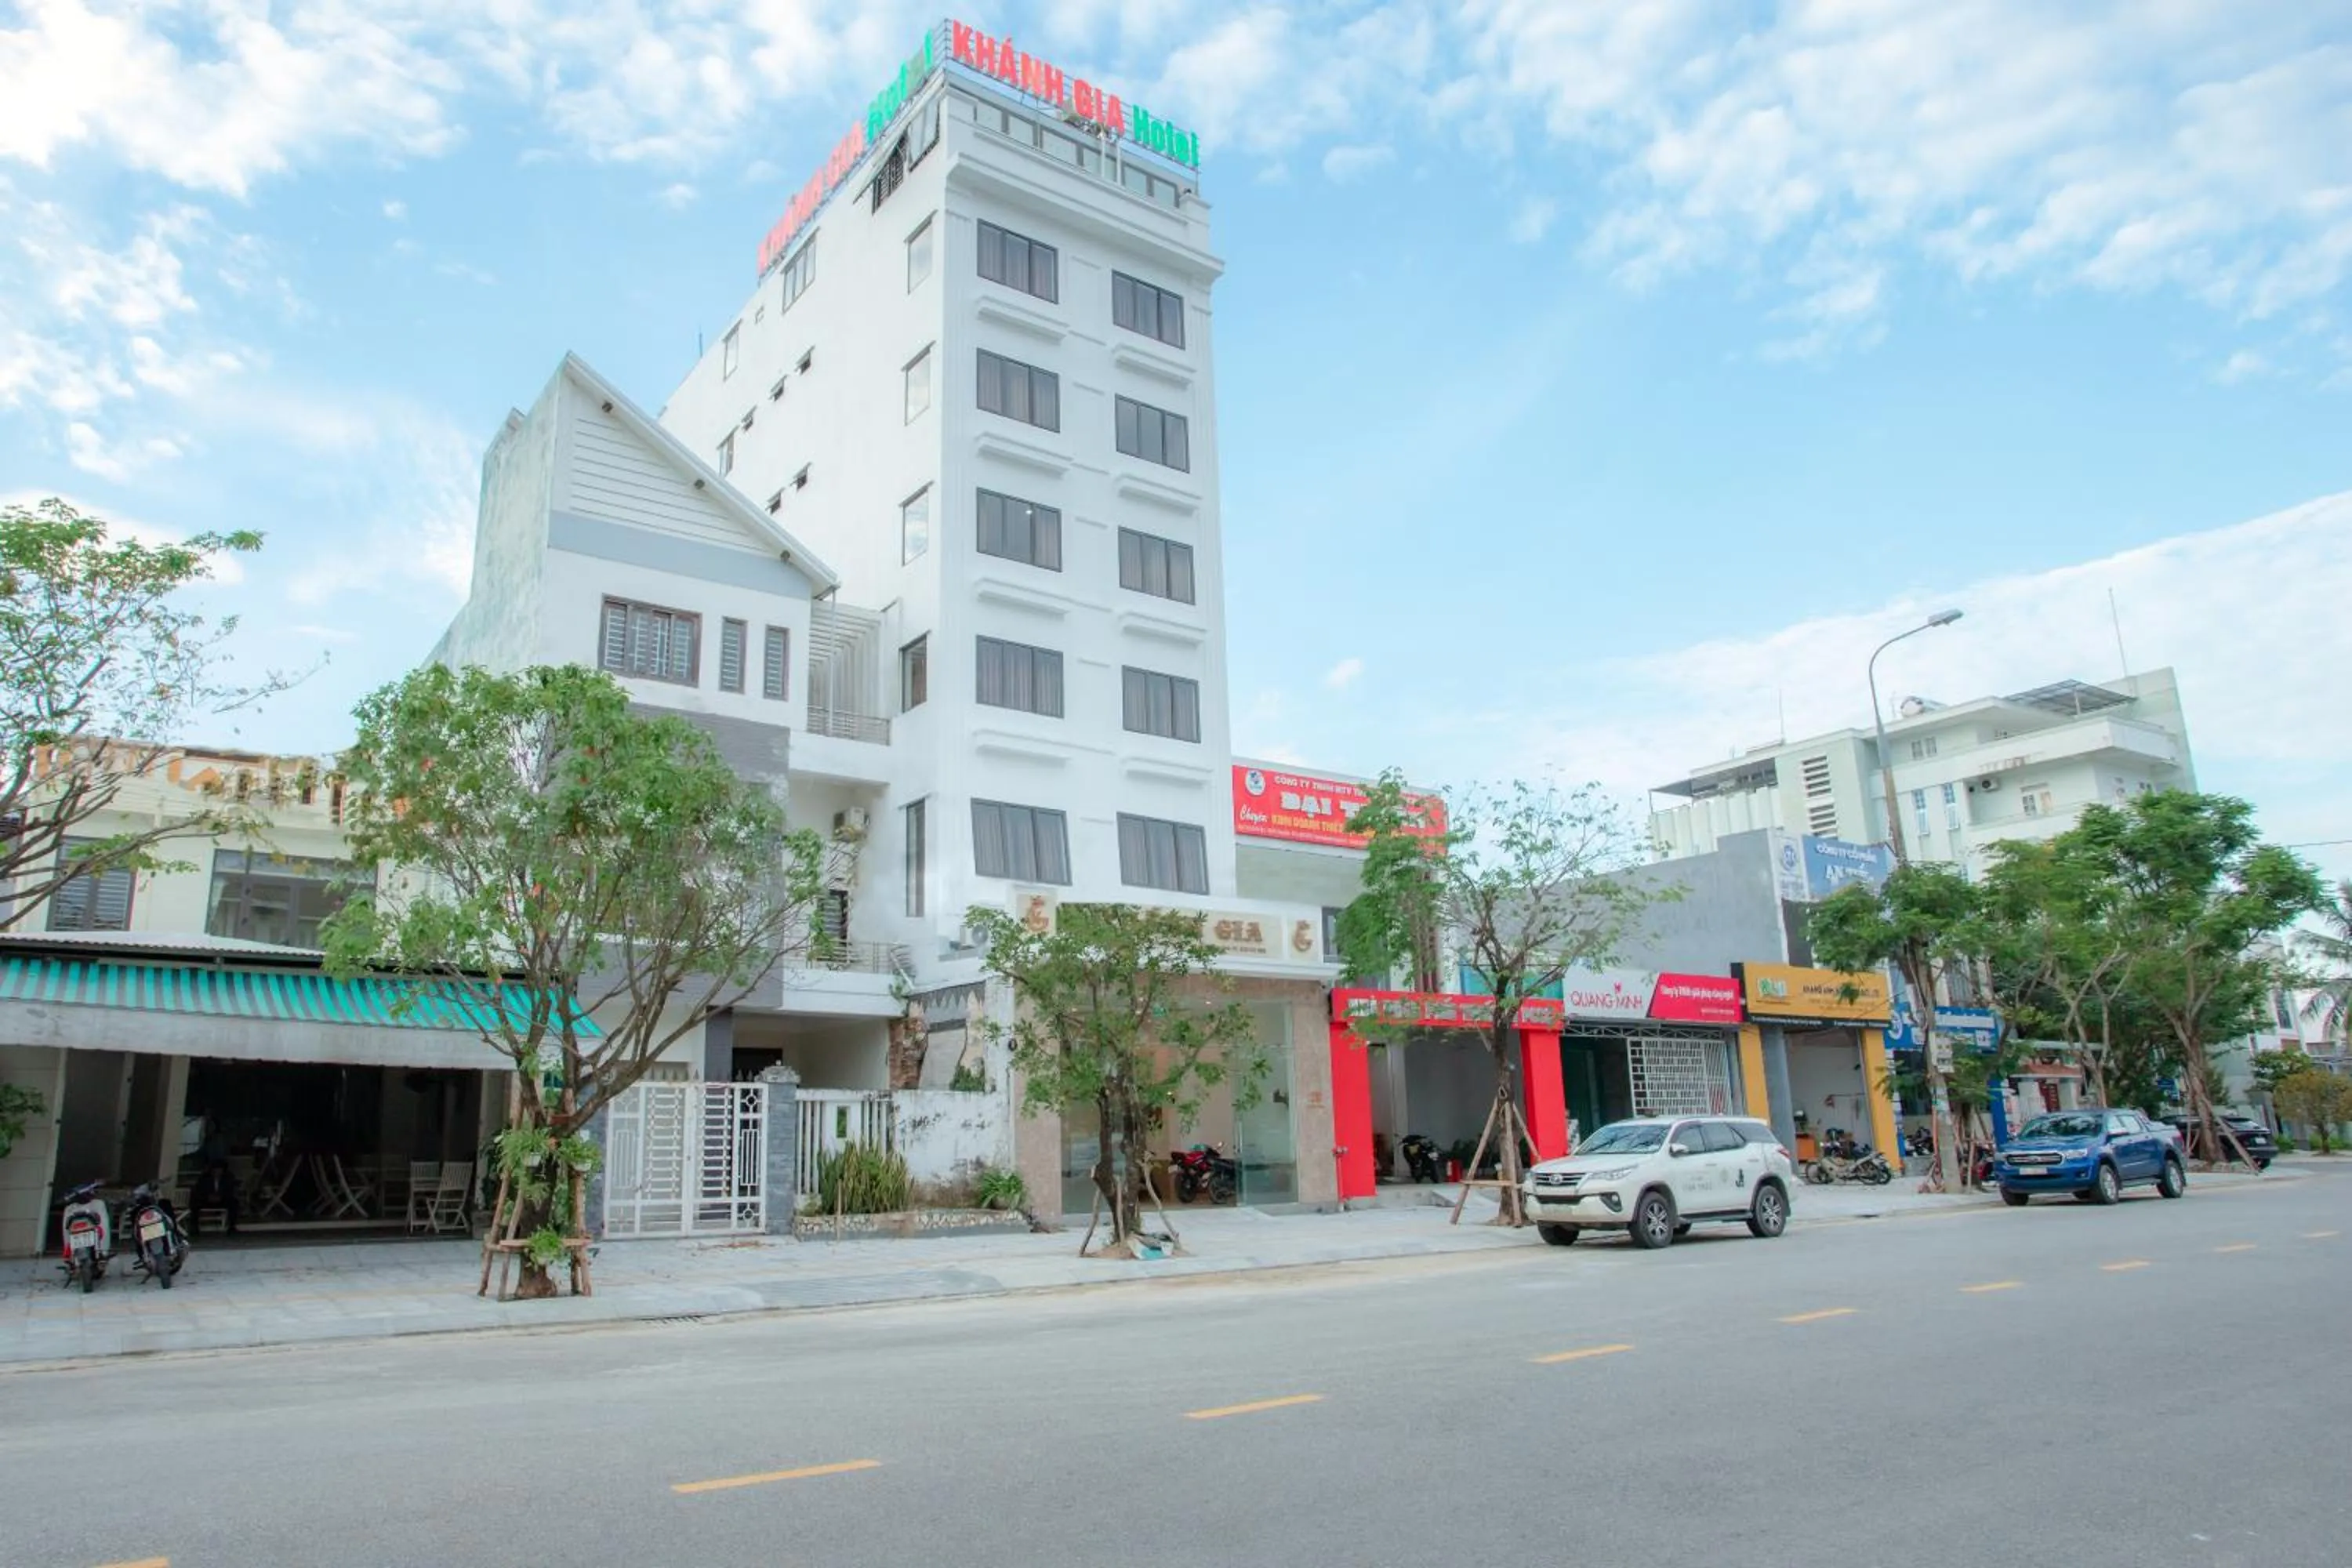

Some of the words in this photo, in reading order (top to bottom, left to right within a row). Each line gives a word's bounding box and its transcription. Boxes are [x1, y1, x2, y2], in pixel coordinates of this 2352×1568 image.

[953, 20, 1065, 107] KHÁNH
[1073, 78, 1126, 137] GIA
[1214, 919, 1262, 942] GIA
